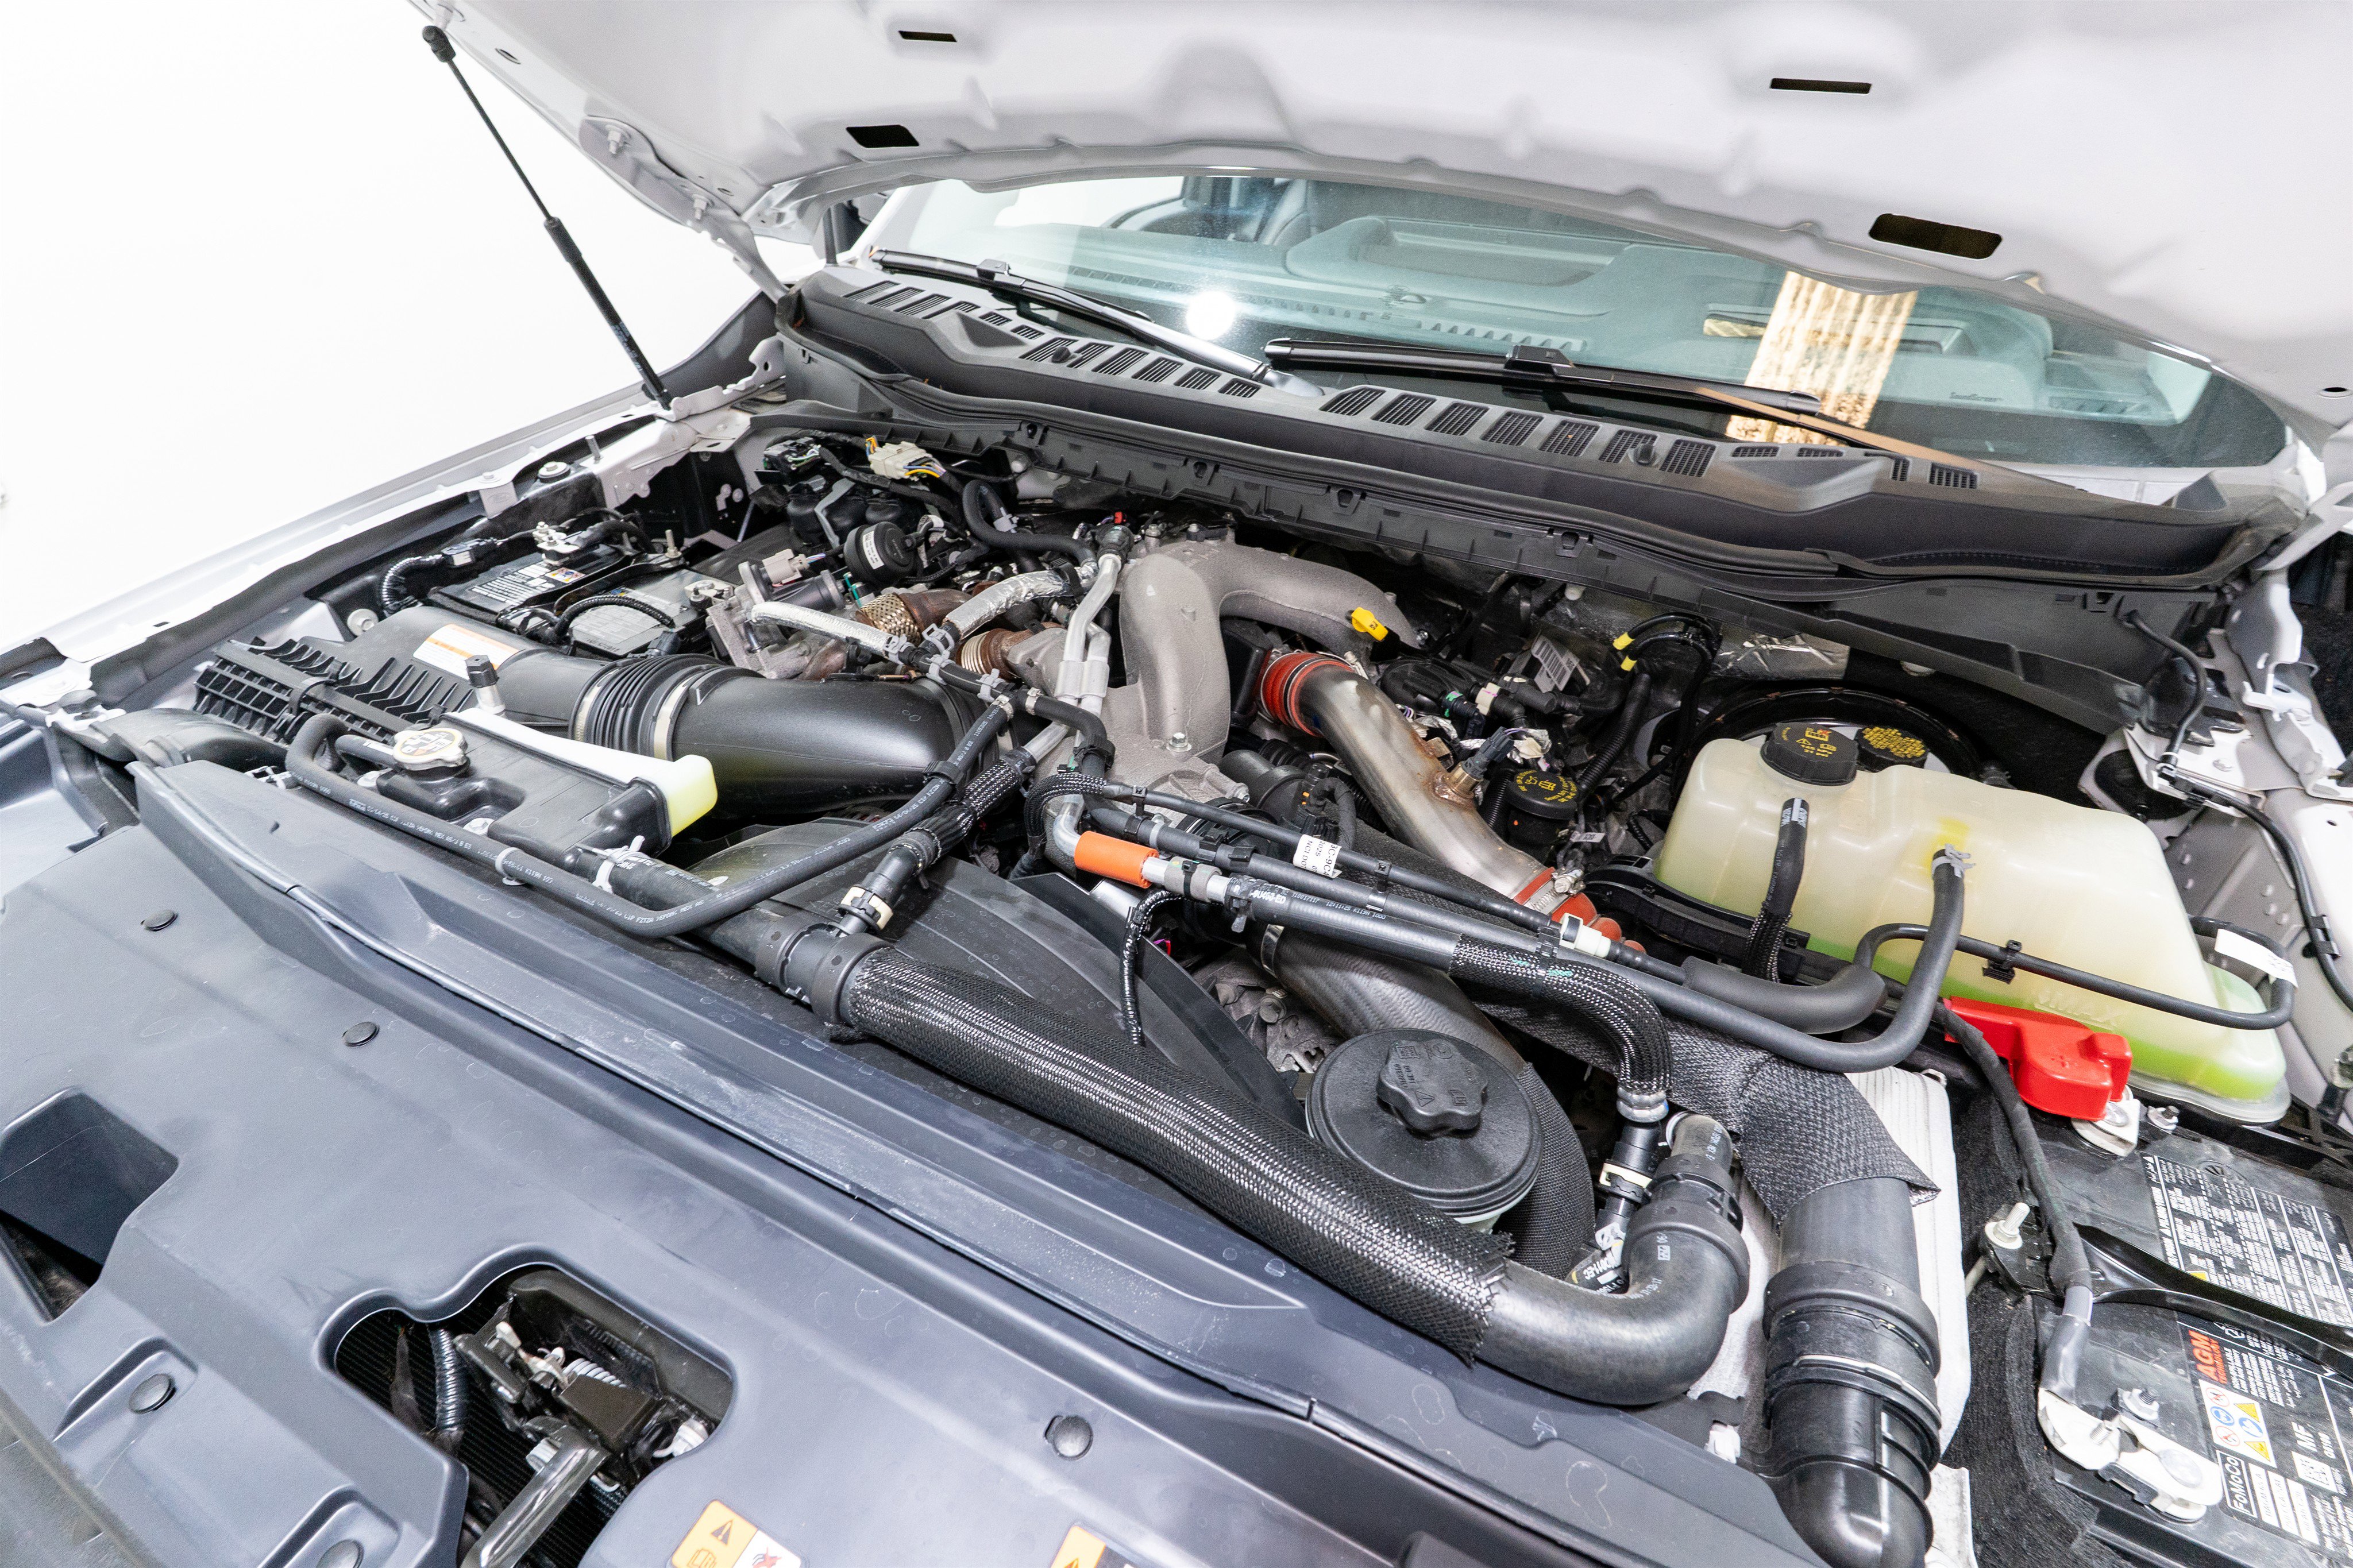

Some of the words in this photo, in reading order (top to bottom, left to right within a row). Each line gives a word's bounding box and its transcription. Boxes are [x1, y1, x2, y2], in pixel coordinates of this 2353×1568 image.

[1304, 840, 1313, 853] NCI
[1316, 841, 1325, 856] 2025
[2189, 1330, 2219, 1382] AGM
[2209, 1338, 2227, 1384] TECHNOLOGY
[2265, 1382, 2277, 1404] CONTRA
[2292, 1422, 2317, 1453] MF
[2225, 1456, 2250, 1512] FoMoCo
